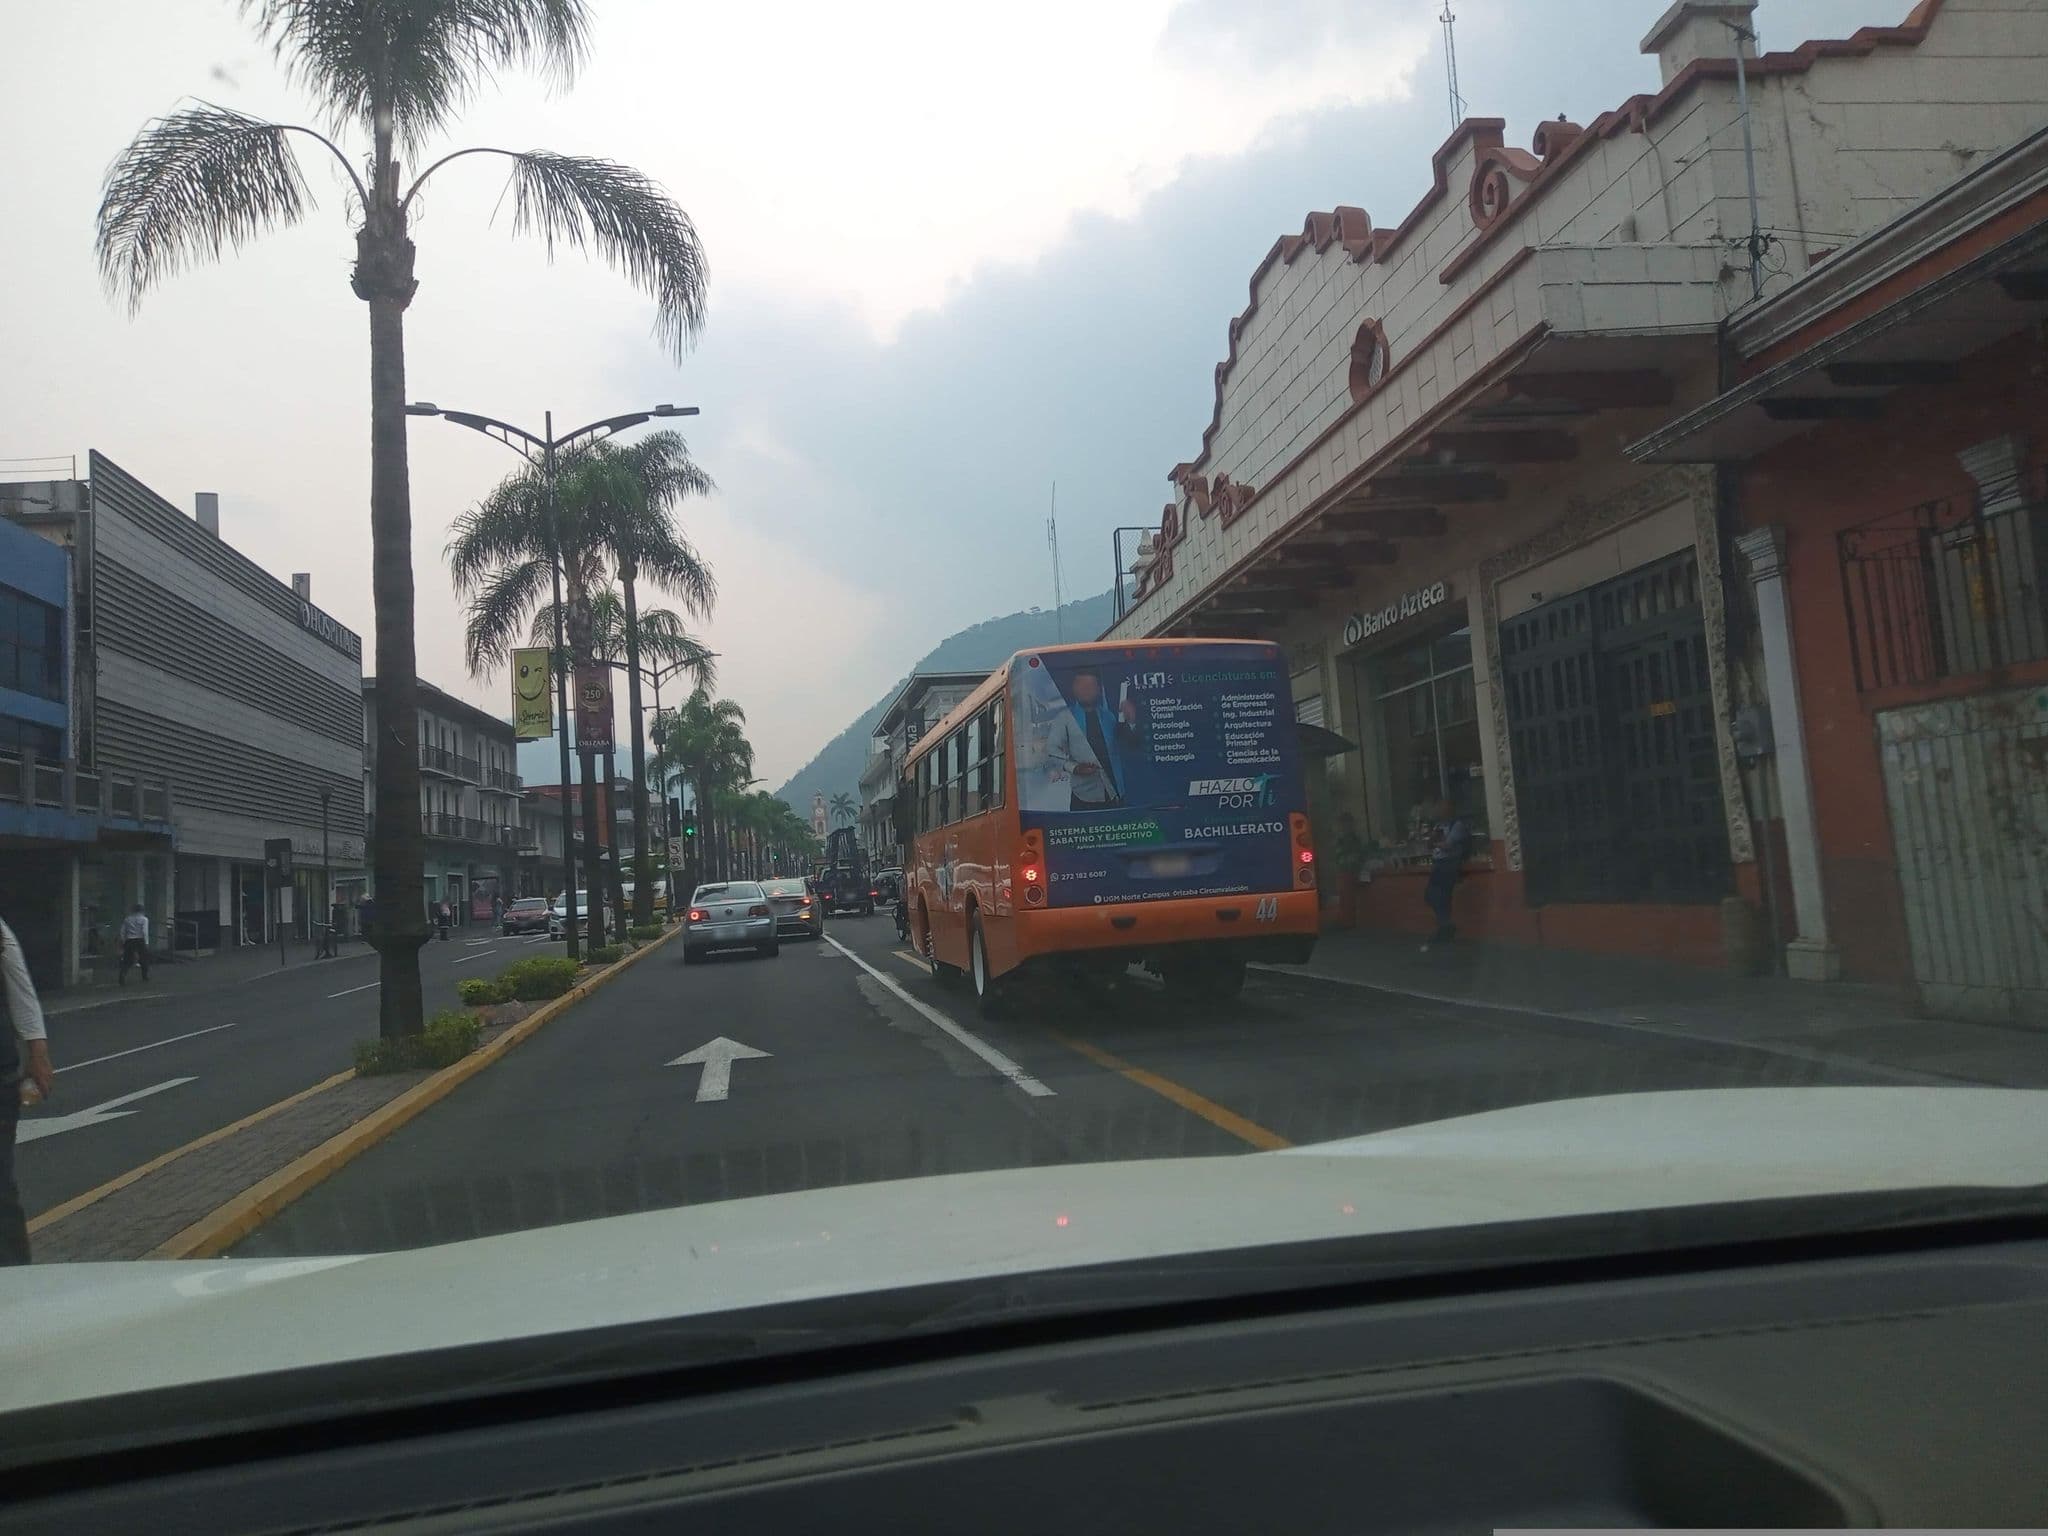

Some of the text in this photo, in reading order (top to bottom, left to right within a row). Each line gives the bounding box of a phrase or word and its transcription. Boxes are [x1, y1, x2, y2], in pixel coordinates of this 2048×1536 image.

[1363, 582, 1445, 638] Banco Azteca
[1181, 672, 1257, 683] Licenciaturas
[585, 689, 602, 699] 250
[1221, 693, 1275, 703] Administración
[1150, 697, 1182, 706] Diseño y
[1221, 700, 1267, 709] de Empresas
[1150, 703, 1203, 714] Comunicación
[1151, 711, 1174, 719] Visual
[1222, 709, 1275, 720] Ing. Industrial
[1152, 720, 1190, 730] Psicología
[1224, 720, 1272, 730] Arquitectura
[1153, 731, 1194, 741] Contaduría
[1225, 731, 1264, 741] Educación
[1154, 743, 1186, 752] Derecho
[1226, 738, 1257, 747] Primaria
[1155, 753, 1195, 763] Pedagogía
[1227, 748, 1279, 759] Ciencias de la
[1227, 755, 1281, 765] Comunicación
[1199, 778, 1255, 795] HAZLO
[1218, 794, 1254, 809] POR
[1049, 828, 1087, 837] SISTEMA
[1184, 822, 1283, 839] BACHILLERATO
[1049, 835, 1095, 846] SABATINO
[1105, 831, 1153, 841] EJECUTIVO
[1061, 873, 1074, 881] 272
[1103, 895, 1120, 903] UGM
[1121, 893, 1141, 901] Norte
[1142, 891, 1170, 901] Campus
[1172, 888, 1198, 898] Orizaba
[1256, 897, 1277, 921] 44
